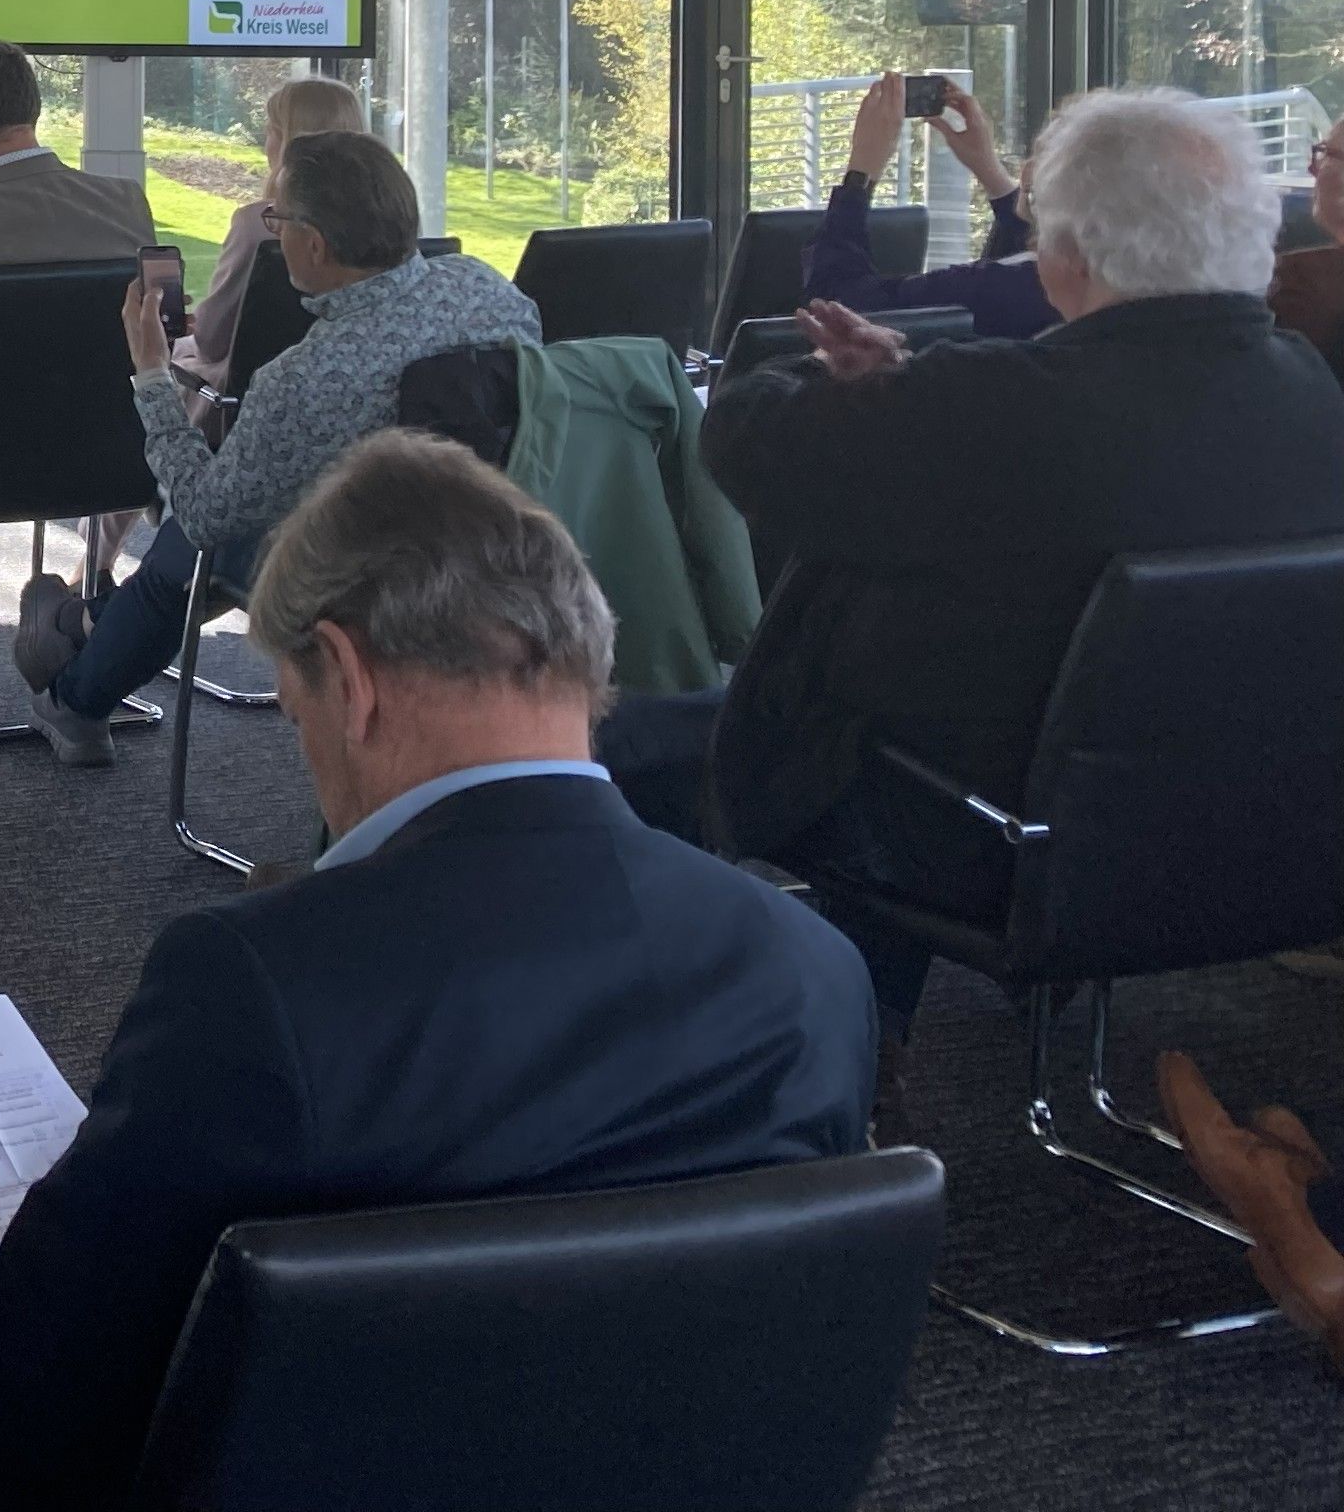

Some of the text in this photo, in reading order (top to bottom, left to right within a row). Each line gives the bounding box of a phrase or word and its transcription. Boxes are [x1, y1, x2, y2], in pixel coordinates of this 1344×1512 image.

[252, 1, 325, 18] Niederrhein
[246, 18, 329, 35] Kreis Wesel
